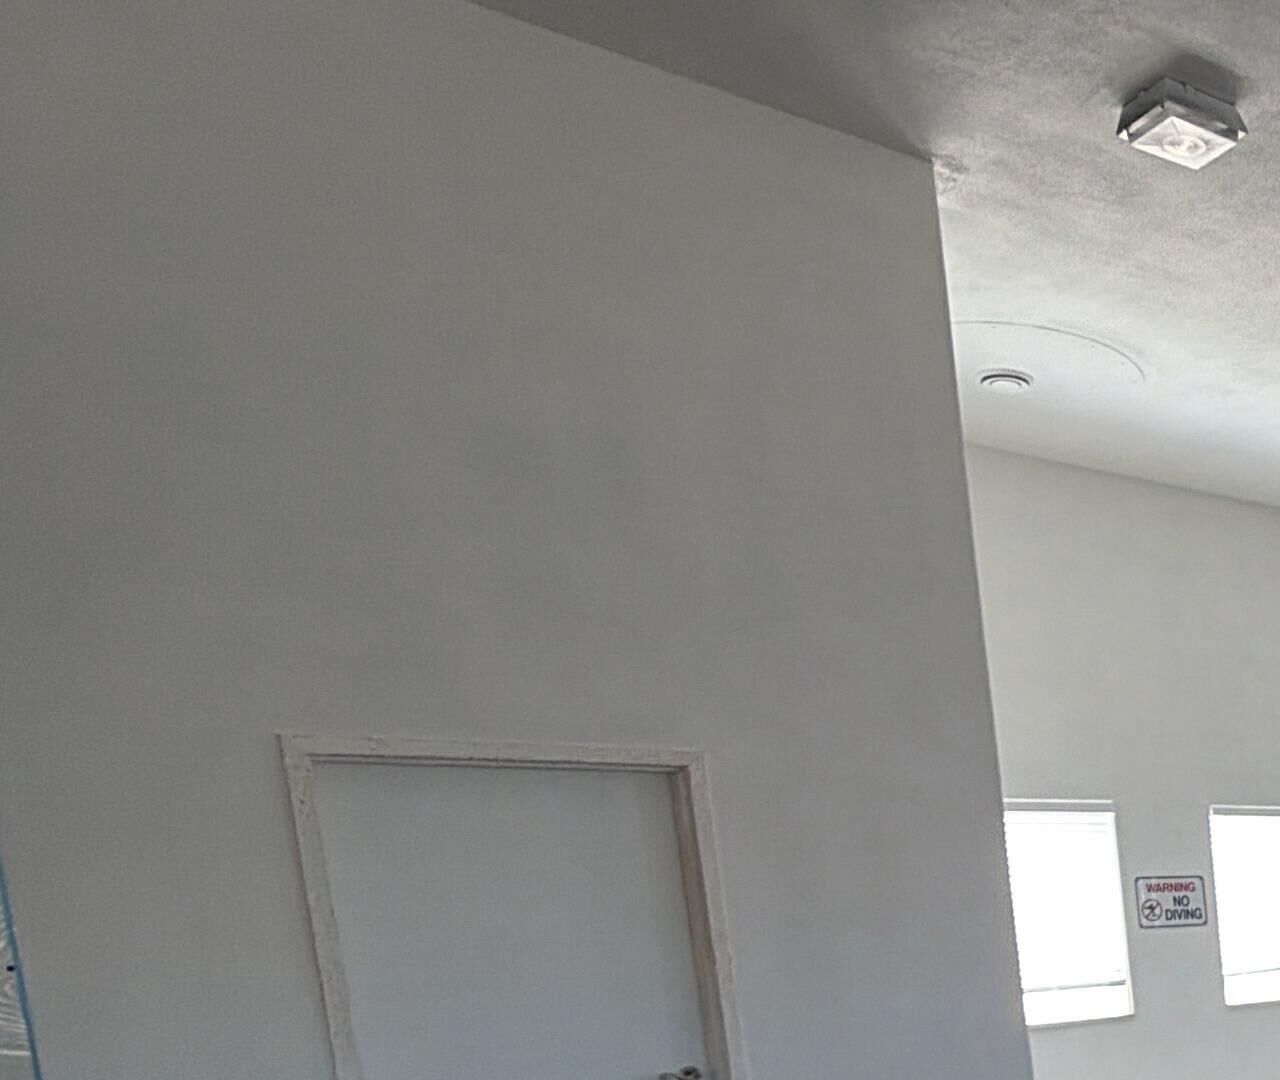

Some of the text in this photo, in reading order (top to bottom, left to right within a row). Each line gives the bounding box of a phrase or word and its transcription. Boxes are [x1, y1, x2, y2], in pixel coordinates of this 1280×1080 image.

[1145, 881, 1196, 893] WARNING
[1172, 895, 1190, 907] NO
[1164, 907, 1203, 921] DIVING
